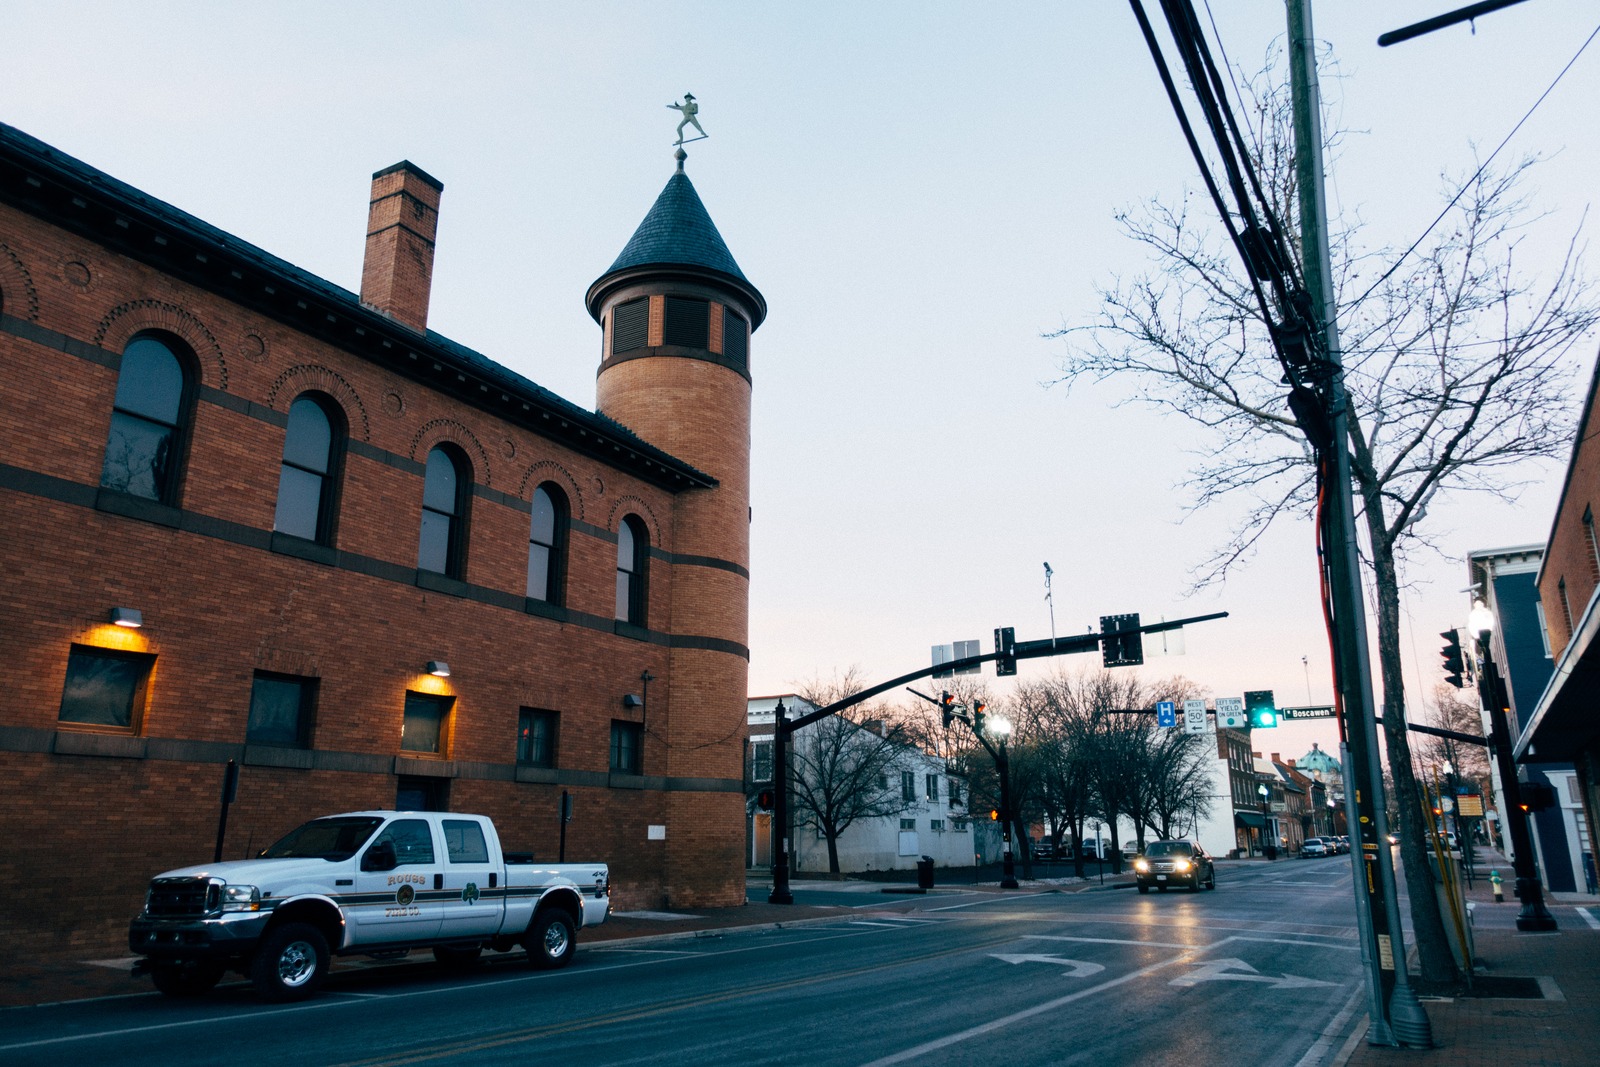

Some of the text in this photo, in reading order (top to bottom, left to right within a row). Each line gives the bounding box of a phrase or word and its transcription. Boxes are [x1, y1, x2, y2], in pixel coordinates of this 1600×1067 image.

[1160, 703, 1171, 716] H
[1219, 704, 1239, 712] YIELD
[1190, 712, 1201, 720] 50
[1292, 709, 1330, 718] Boscawen
[387, 873, 426, 886] ROUSS
[385, 907, 407, 917] FIRE
